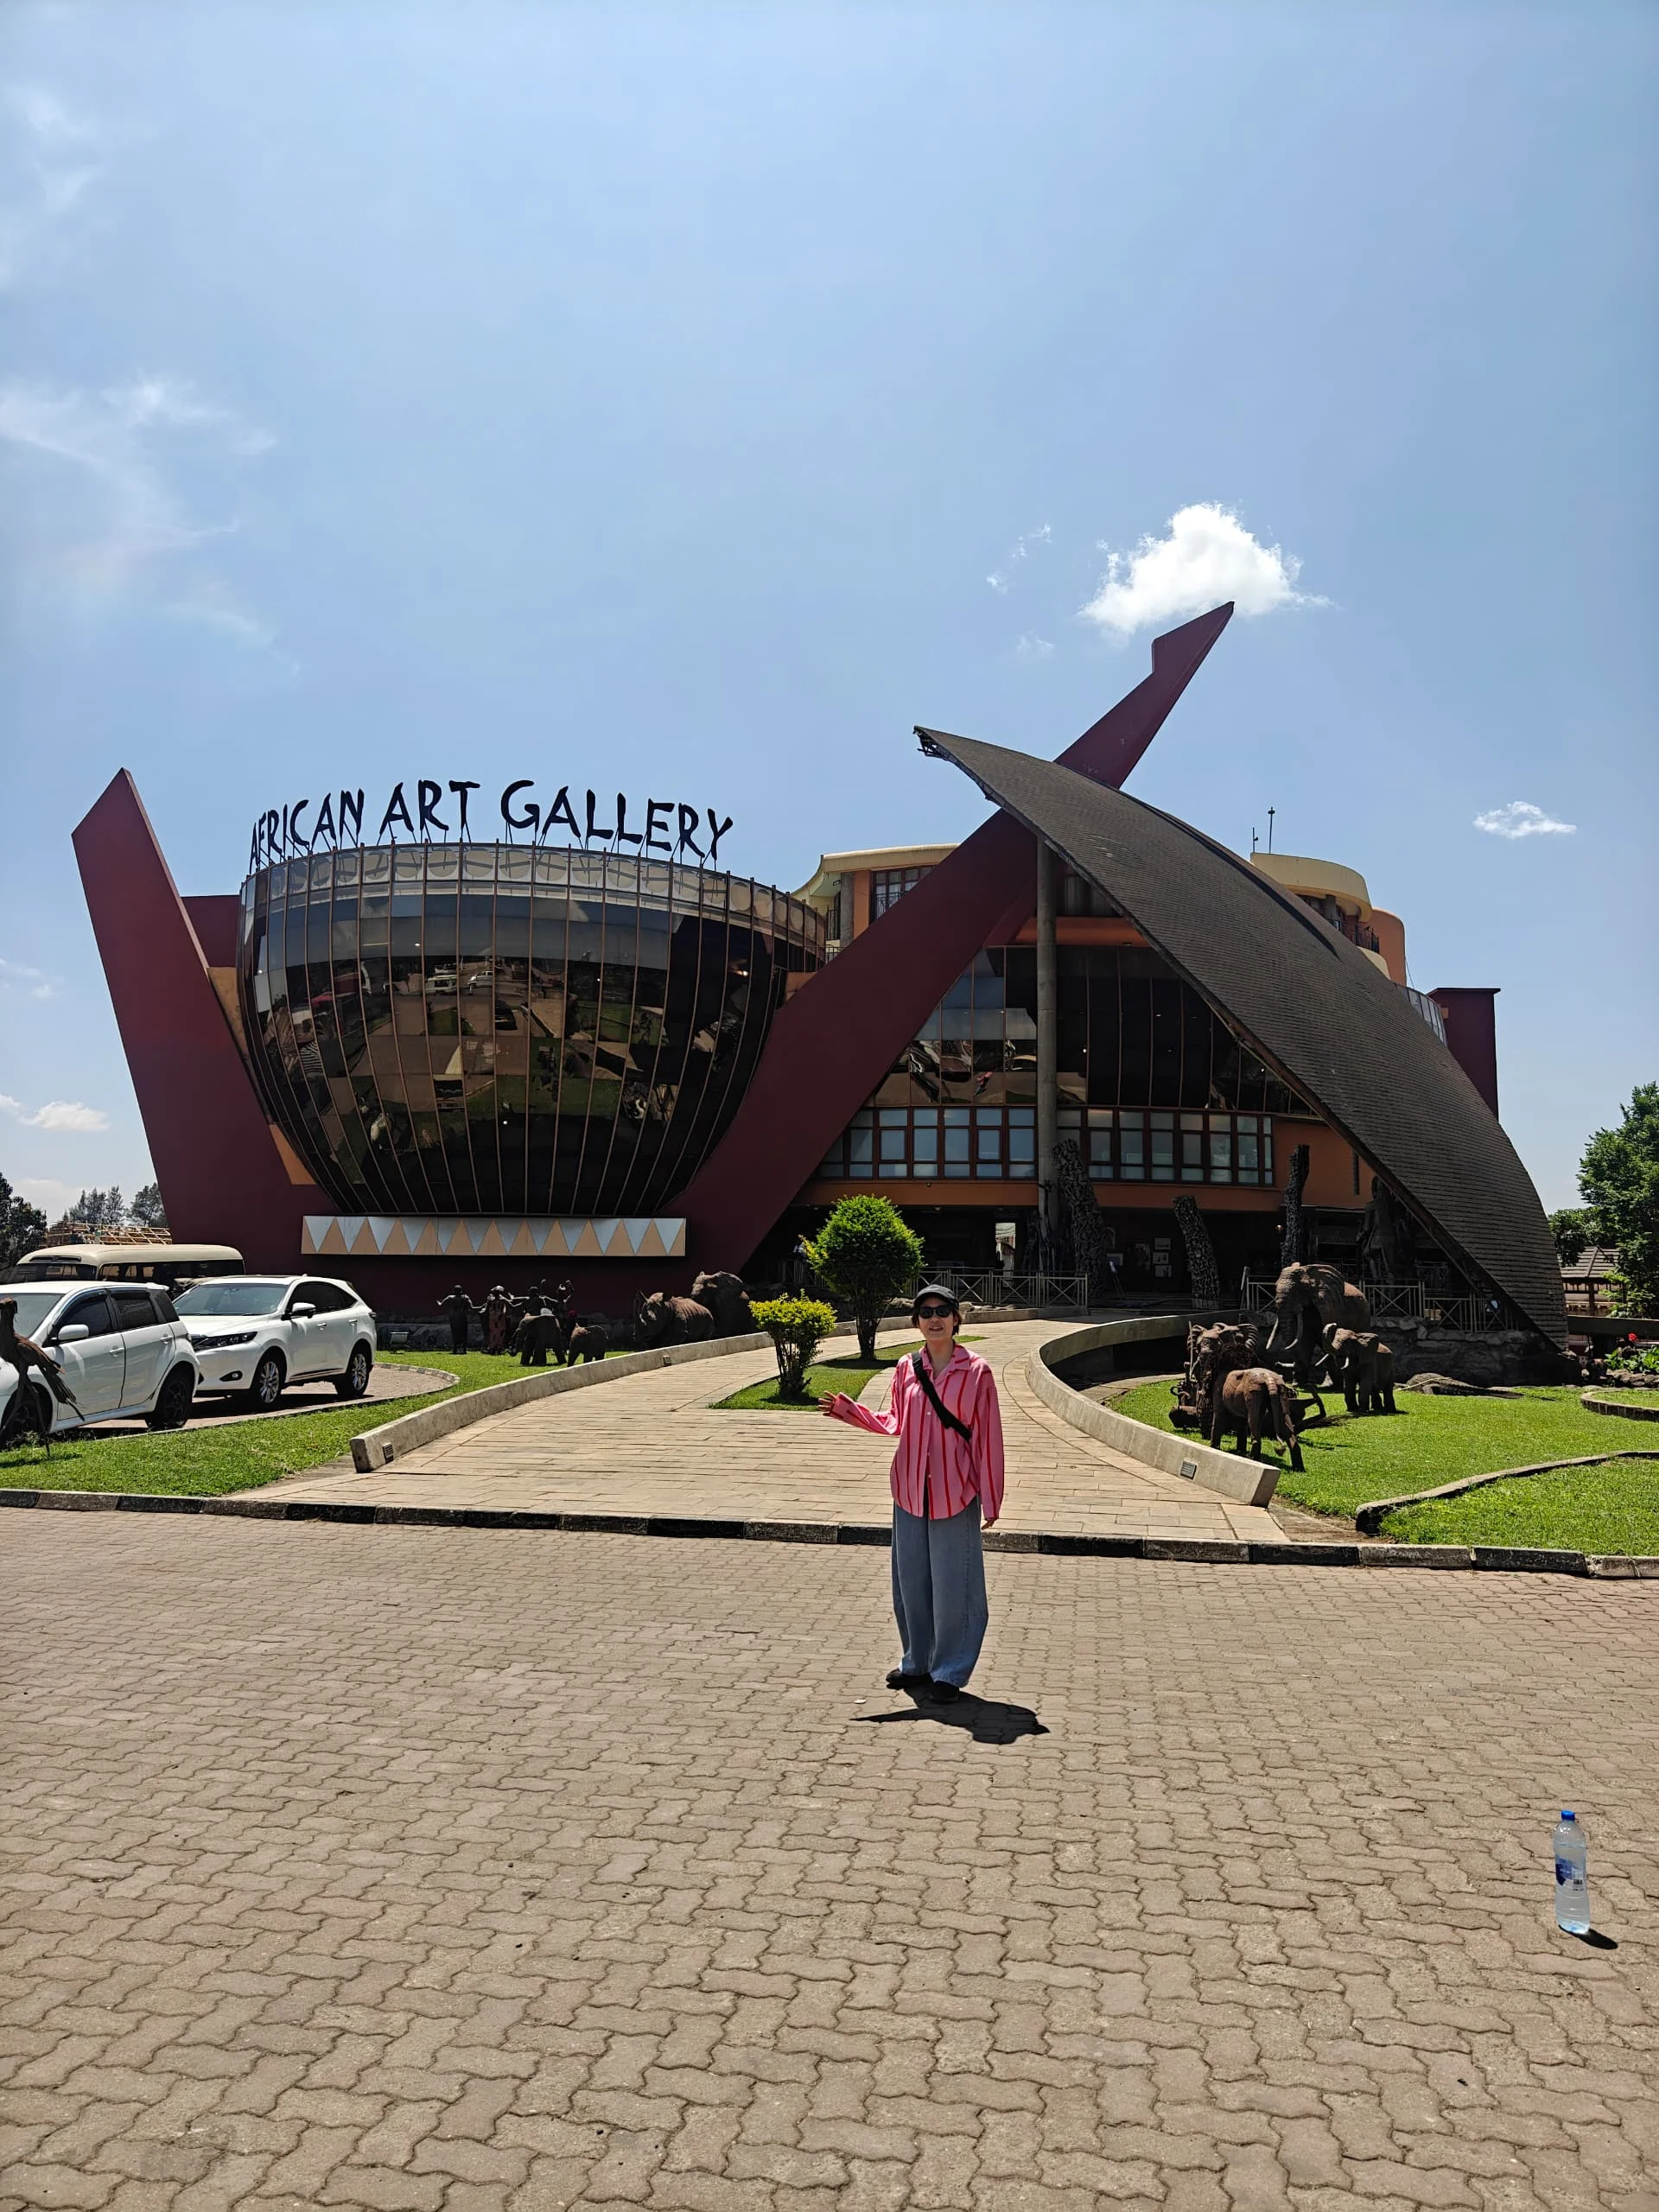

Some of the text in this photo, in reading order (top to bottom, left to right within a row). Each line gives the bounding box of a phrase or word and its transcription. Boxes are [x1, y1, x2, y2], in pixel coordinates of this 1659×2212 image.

[249, 779, 733, 868] AFRICAN ART GALLERY
